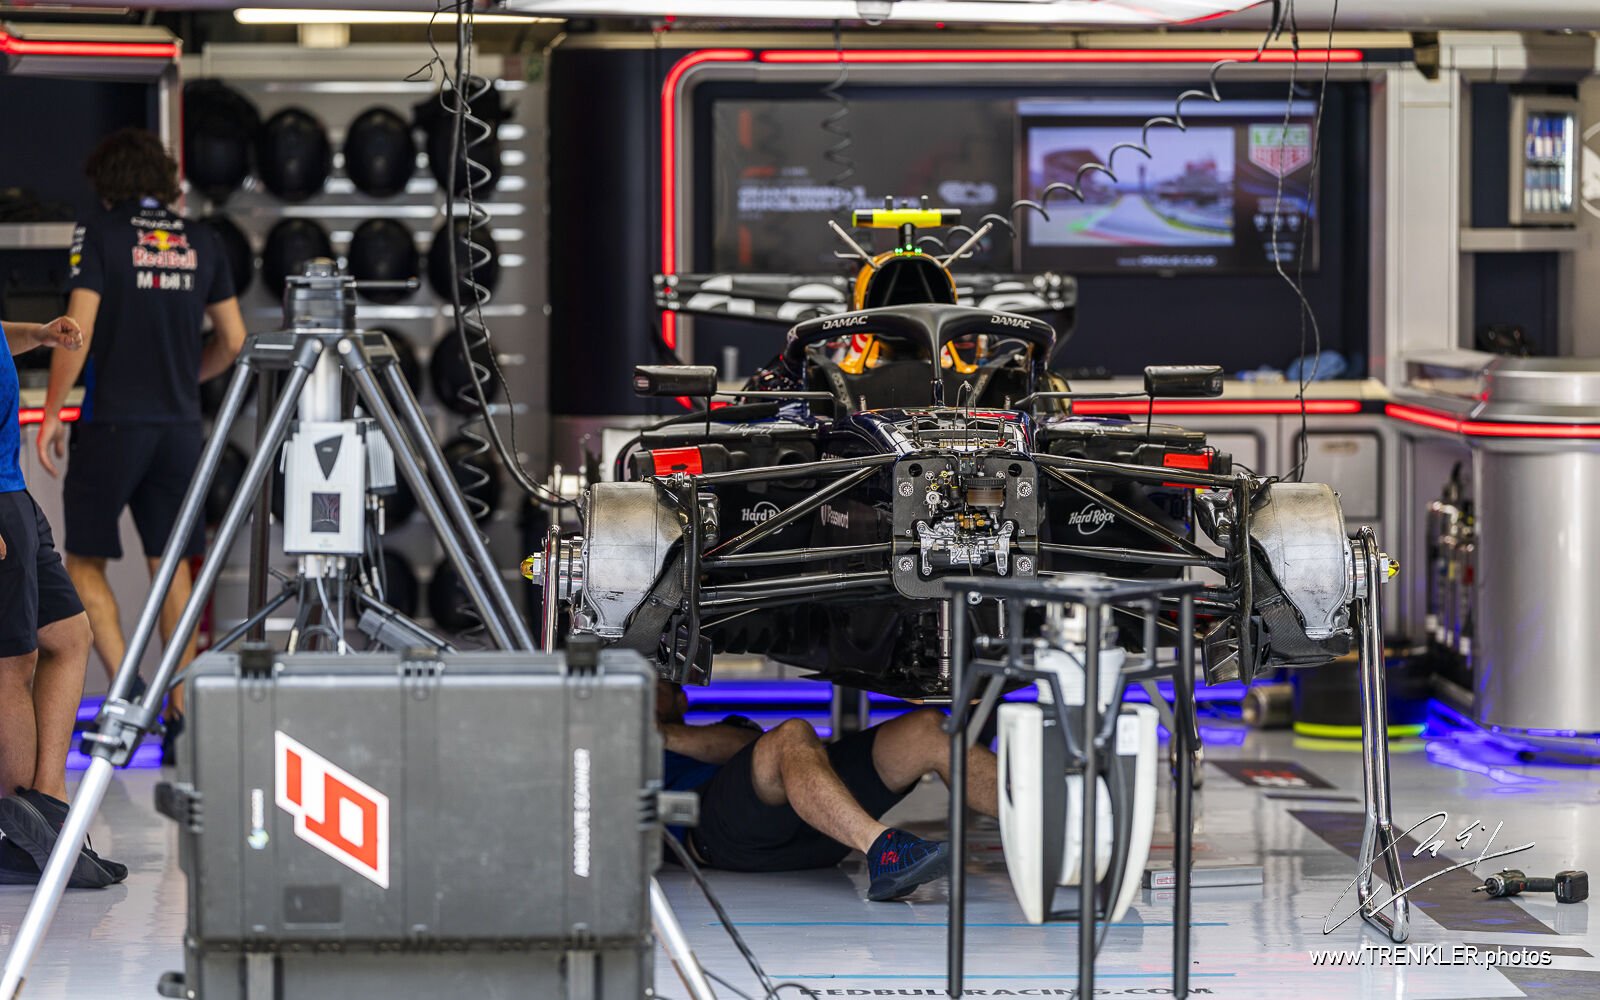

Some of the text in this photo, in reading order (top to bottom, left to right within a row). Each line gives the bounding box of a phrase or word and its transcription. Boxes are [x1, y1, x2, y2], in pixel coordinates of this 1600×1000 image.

[137, 271, 181, 290] Mobil
[822, 315, 869, 330] DAMAC
[990, 314, 1032, 329] DAMAC
[741, 508, 767, 521] Hard
[1068, 509, 1116, 525] Hard Rock
